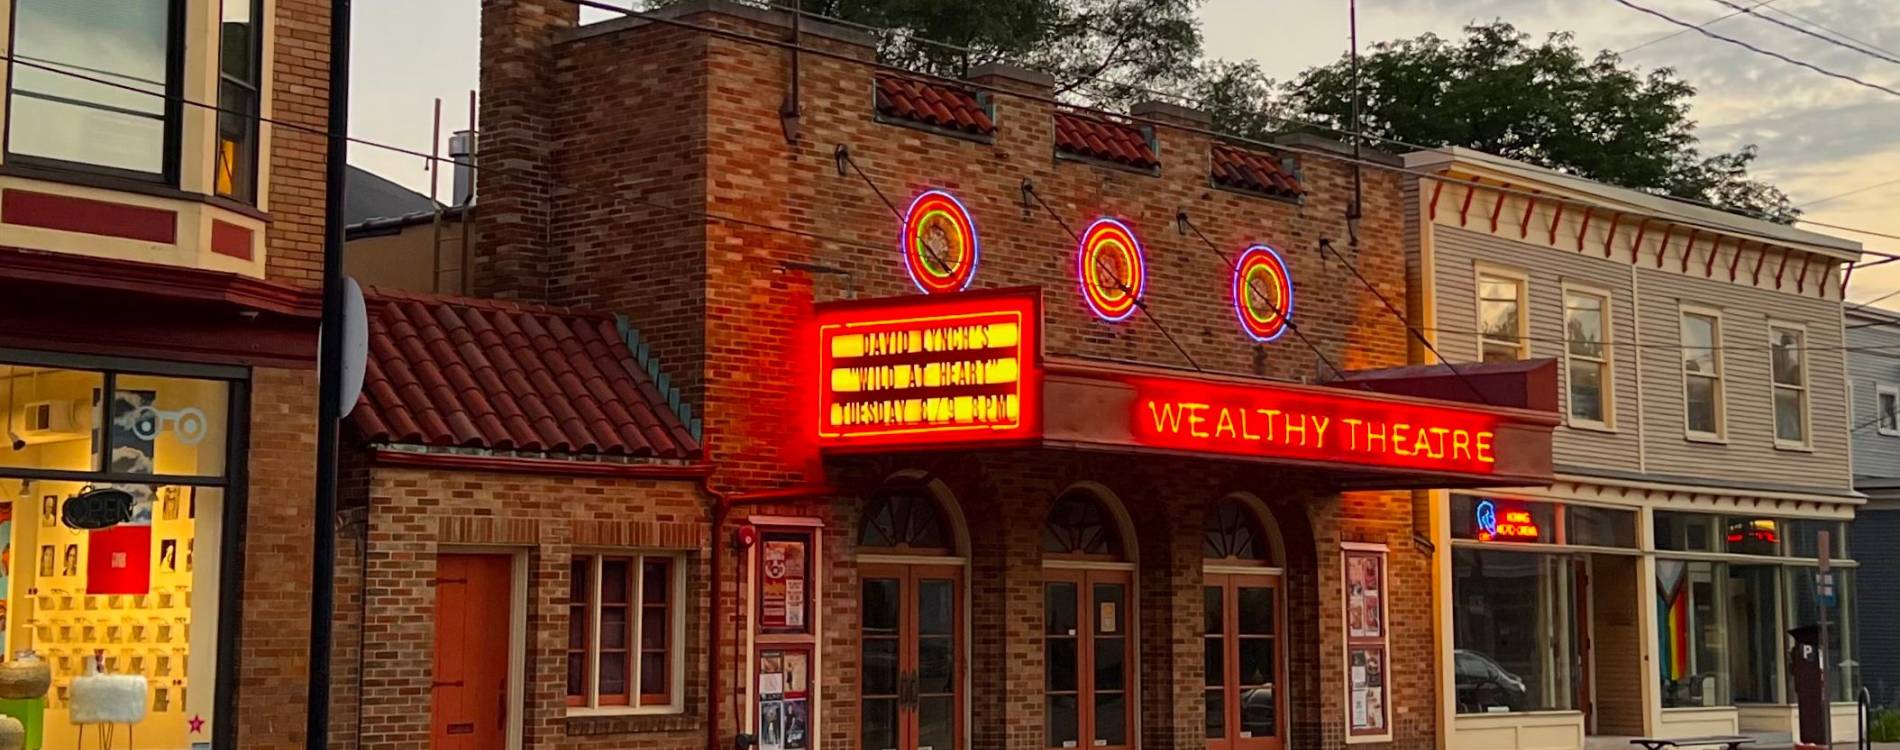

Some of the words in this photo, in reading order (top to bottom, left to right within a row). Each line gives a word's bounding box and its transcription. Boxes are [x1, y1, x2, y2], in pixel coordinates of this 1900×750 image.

[863, 332, 910, 355] DAVID
[924, 325, 990, 351] LYNCH'S
[908, 364, 926, 388] AT
[940, 360, 998, 386] HEART"
[839, 401, 906, 426] TUESDAY
[971, 394, 1008, 420] 8PM
[1148, 401, 1328, 448] WEALTHY
[1343, 419, 1494, 462] THEATRE
[66, 497, 132, 522] OPEN
[1803, 644, 1813, 659] P
